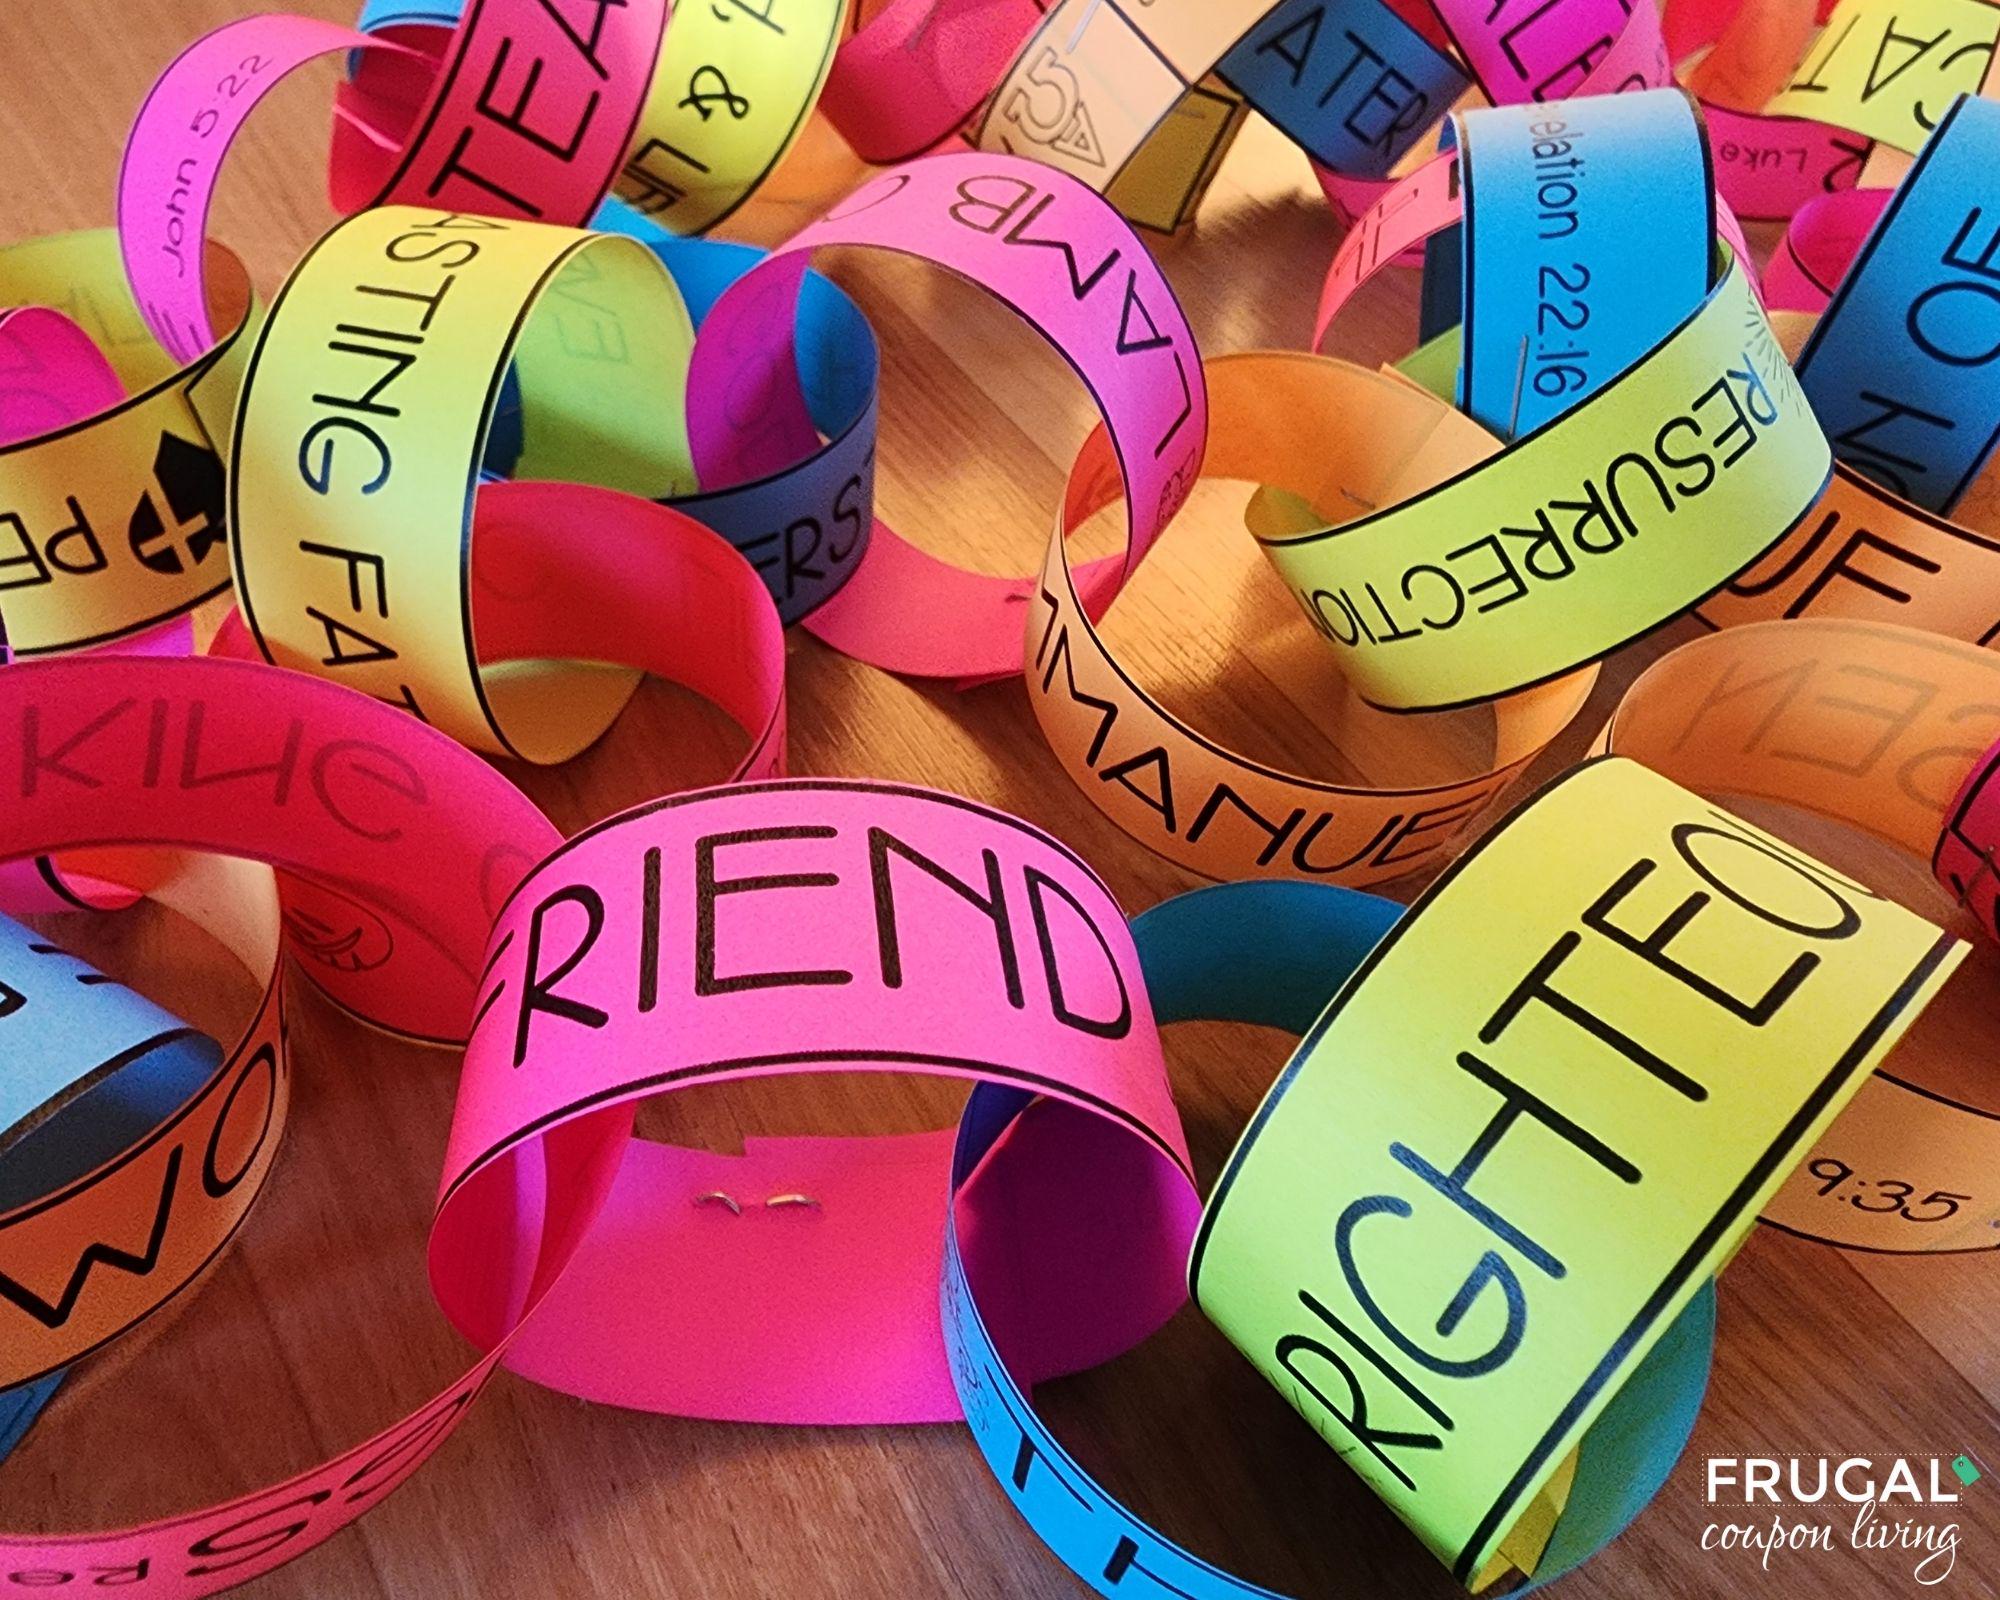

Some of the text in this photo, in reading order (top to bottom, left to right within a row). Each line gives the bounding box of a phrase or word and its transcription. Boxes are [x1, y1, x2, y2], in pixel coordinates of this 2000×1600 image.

[679, 65, 750, 121] &
[1719, 142, 1808, 174] Luke
[161, 157, 197, 278] John
[948, 174, 1194, 461] LAMB
[1532, 104, 1591, 398] elation 22:16
[0, 1030, 283, 1327] WO
[1275, 810, 1873, 1492] RIGHTEO
[1807, 1158, 1972, 1222] 9:35
